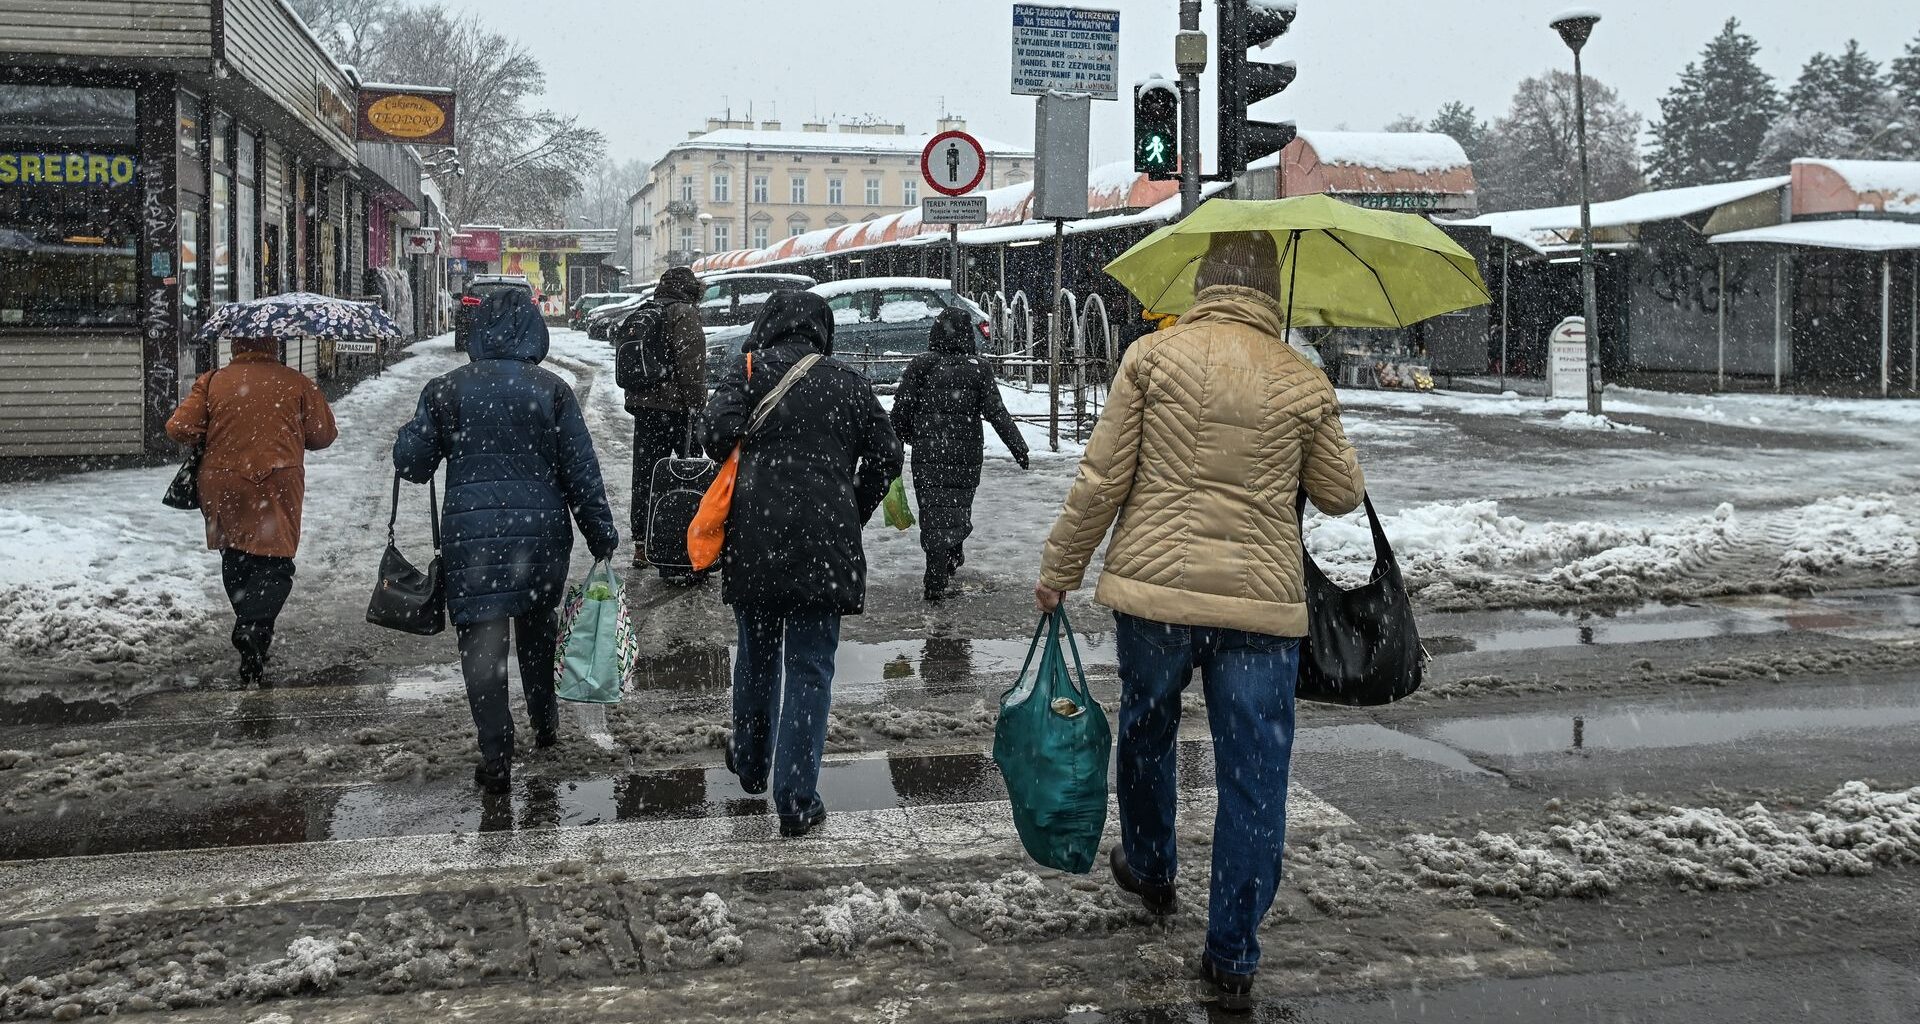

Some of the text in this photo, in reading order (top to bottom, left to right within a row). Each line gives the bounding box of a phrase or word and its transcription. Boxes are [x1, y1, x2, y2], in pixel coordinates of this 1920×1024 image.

[1036, 8, 1072, 18] TARGOWY
[1024, 17, 1111, 30] NA TERENIE PRYWATNYM
[1021, 28, 1048, 36] CZYNNE
[1062, 40, 1091, 49] NIEDZIEL
[1026, 49, 1065, 58] GODZINACH
[1068, 61, 1111, 71] ZEZWOLENIA
[1024, 69, 1071, 79] PRZEBYWANIE
[374, 112, 439, 128] TEODORA
[0, 154, 134, 184] SREBRO
[1360, 194, 1440, 208] PAPIEROSY
